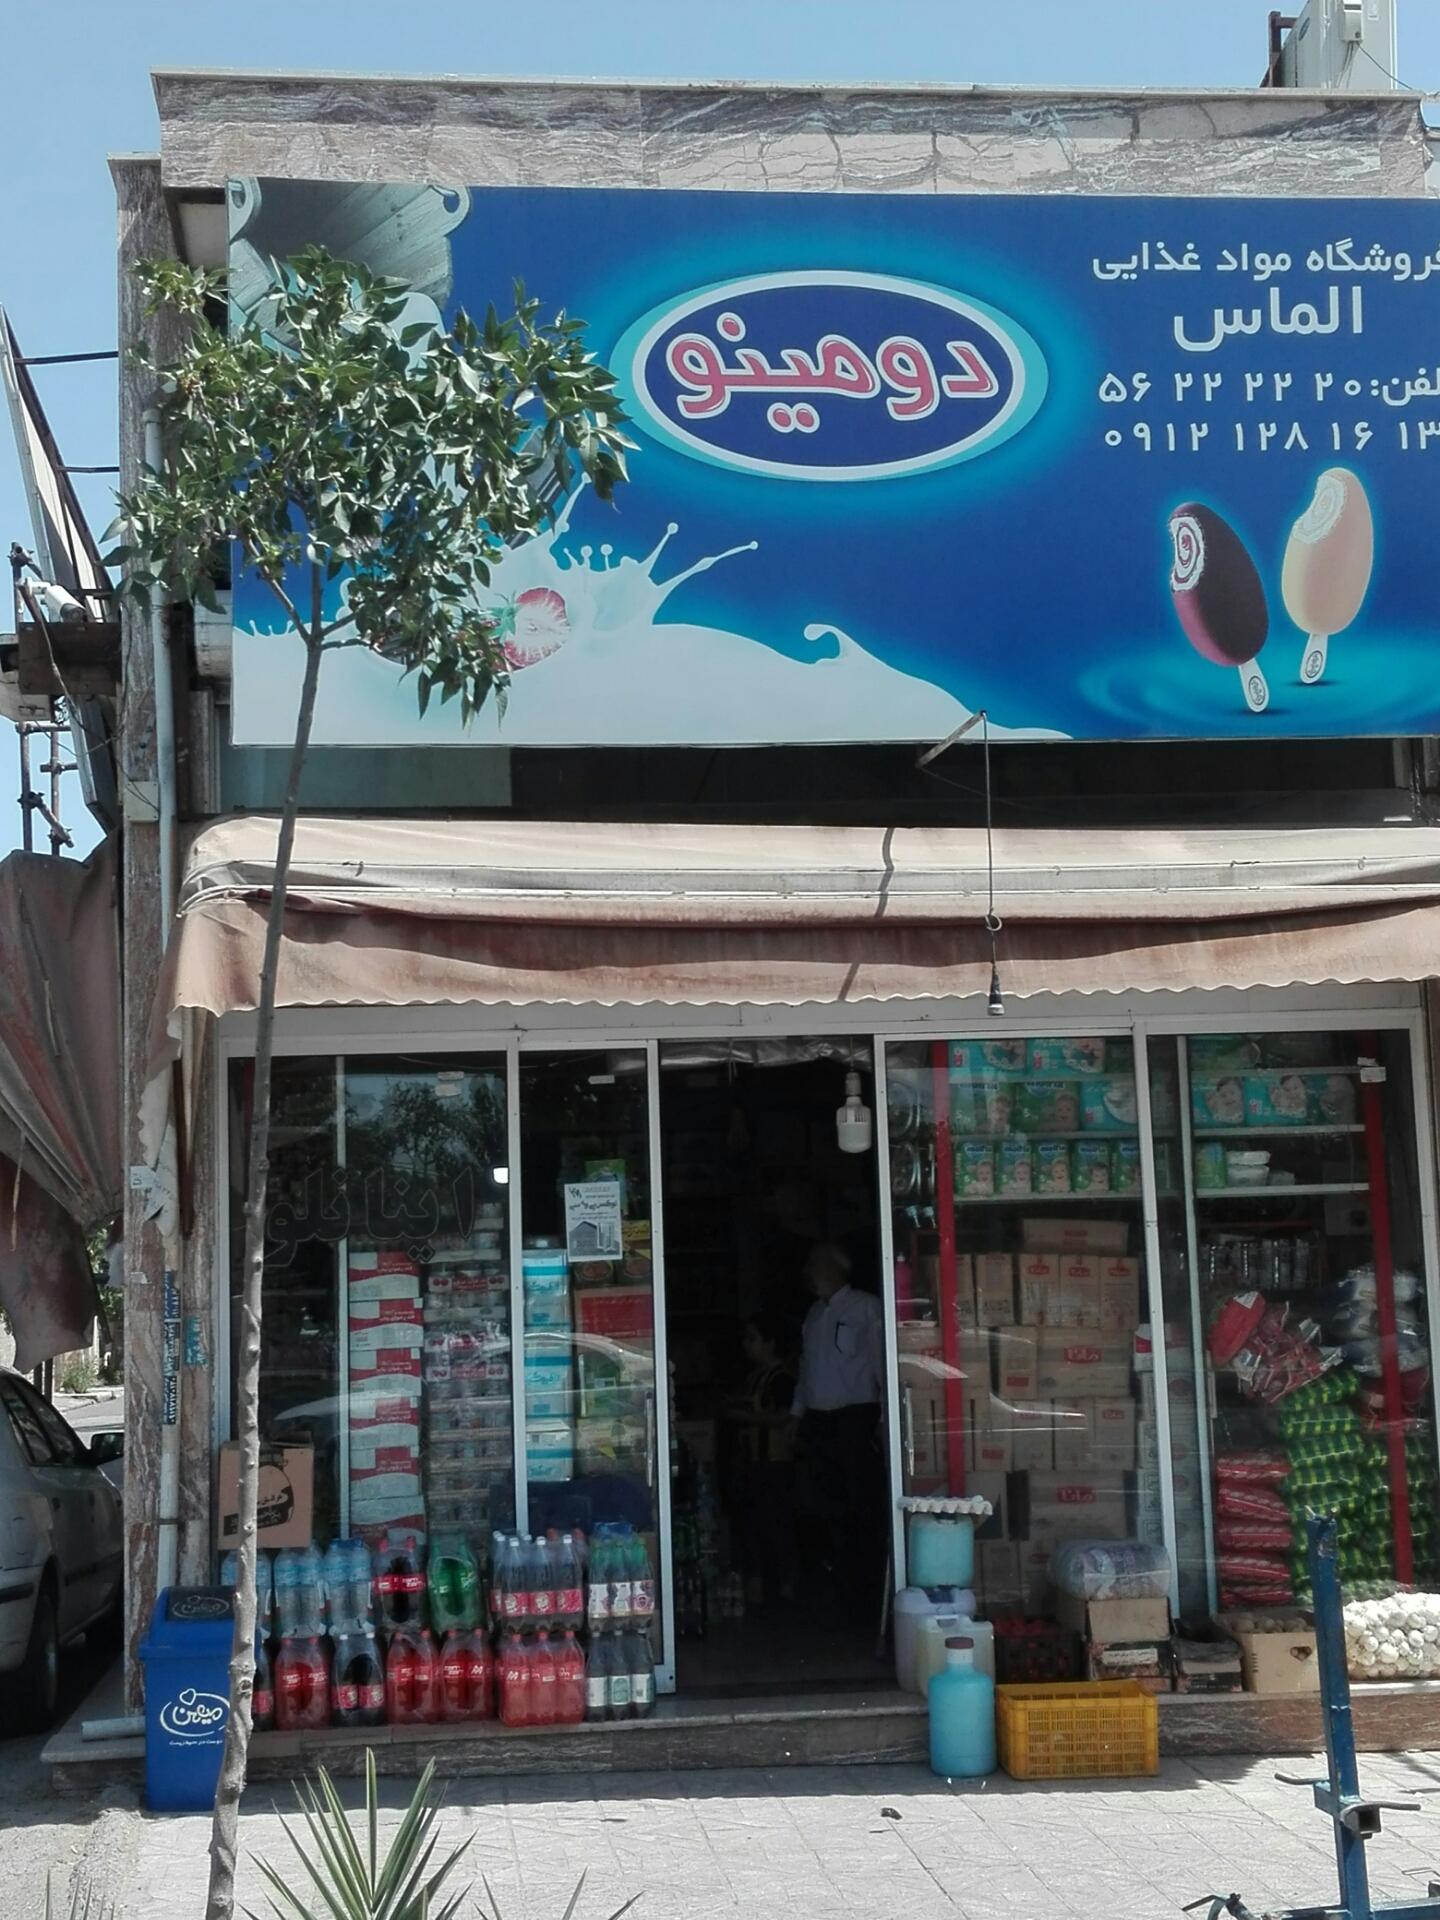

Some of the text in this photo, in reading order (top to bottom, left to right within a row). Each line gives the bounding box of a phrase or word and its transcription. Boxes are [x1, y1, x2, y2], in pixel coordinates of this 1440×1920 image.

[1092, 241, 1201, 281] غذایی
[1216, 241, 1292, 281] مواد
[1173, 285, 1363, 352] الماس
[666, 311, 1000, 434] دومینو
[1098, 372, 1152, 402] ۵۶
[1174, 372, 1222, 402] ۲۲
[1244, 372, 1292, 402] ۲۲
[1370, 367, 1440, 407] لفن:
[1104, 422, 1209, 451] ۰۹۱۲
[1235, 422, 1309, 451] ۱۲۸
[1331, 422, 1374, 451] ۱۶
[172, 1703, 224, 1726] میهن
